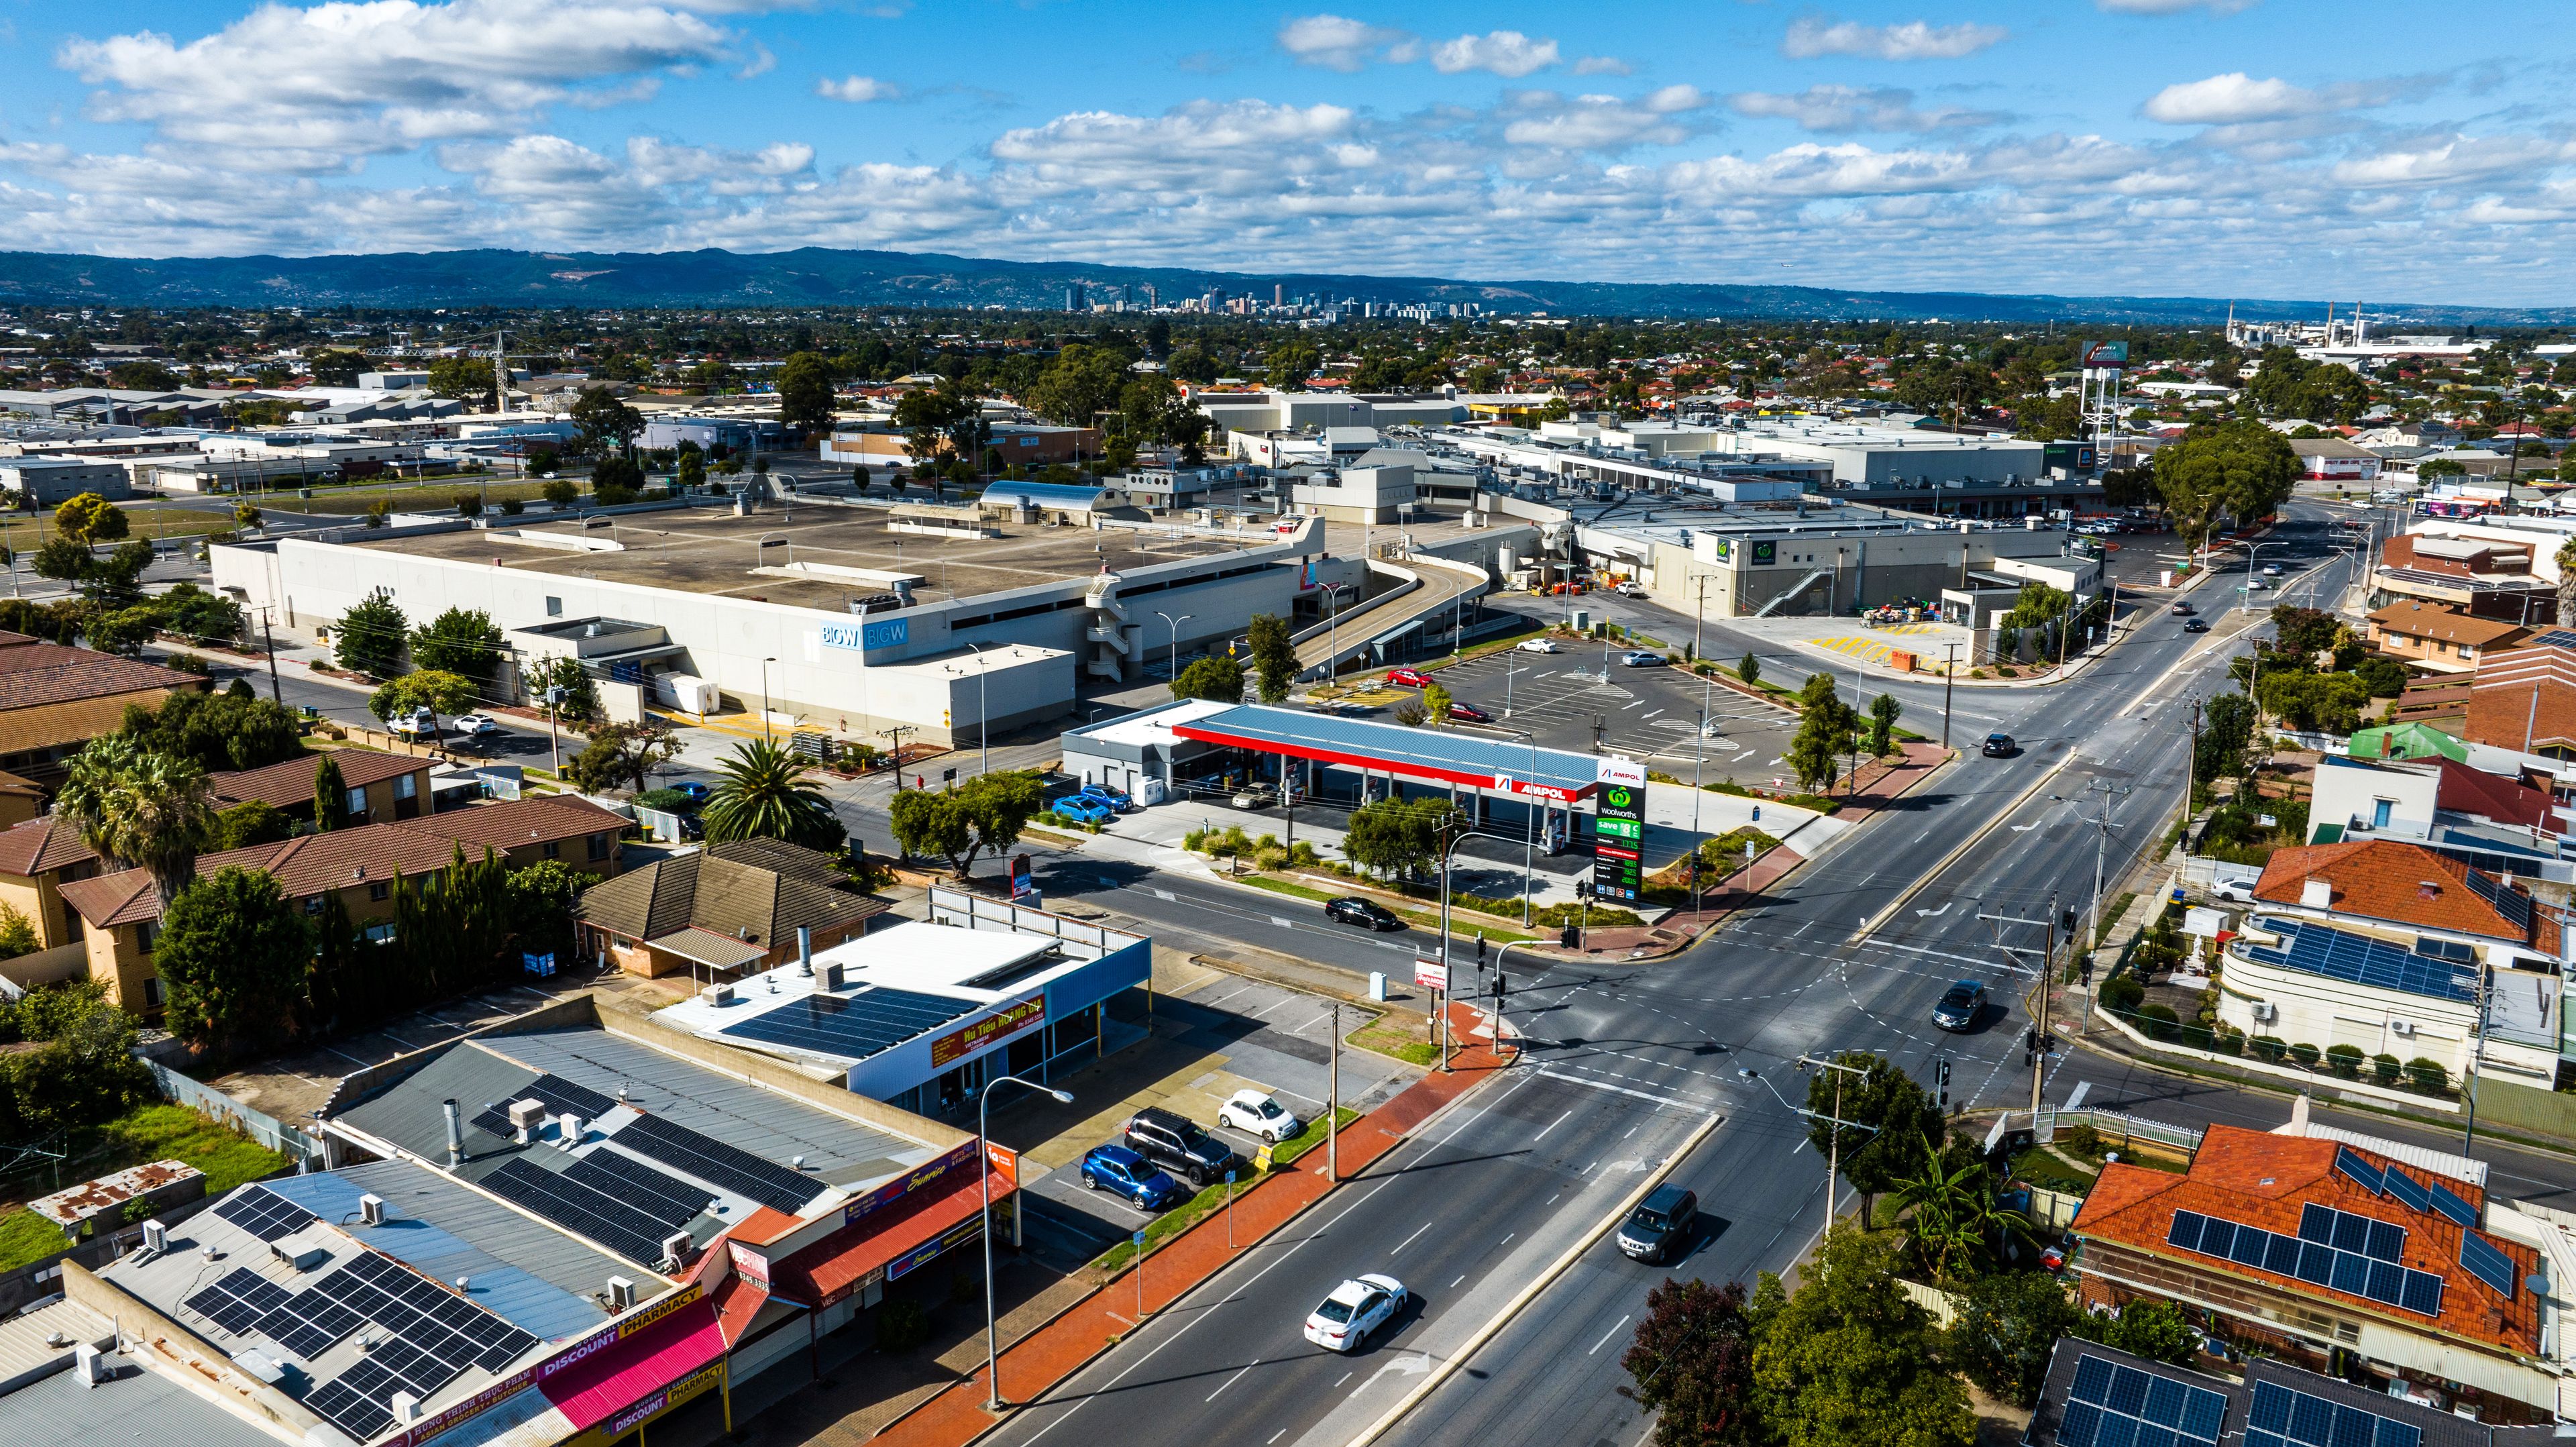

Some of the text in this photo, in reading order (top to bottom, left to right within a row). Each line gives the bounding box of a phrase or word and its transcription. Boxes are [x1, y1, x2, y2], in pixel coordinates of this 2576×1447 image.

[1521, 784, 1566, 800] AMPOL
[1613, 772, 1640, 780] AMPOL
[1599, 821, 1618, 830] save
[1601, 807, 1637, 819] Woolworths
[907, 1163, 947, 1191] Sunrise
[544, 1290, 697, 1376] DISCOUNT PHARMACY
[575, 1298, 668, 1348] WOODVILLE GARDENS
[615, 1366, 722, 1432] DISCOUNT PHARMACY
[635, 1371, 699, 1409] WOODVILLE GARDENS
[420, 1381, 528, 1441] ASIAN GROCERY BUTCHER
